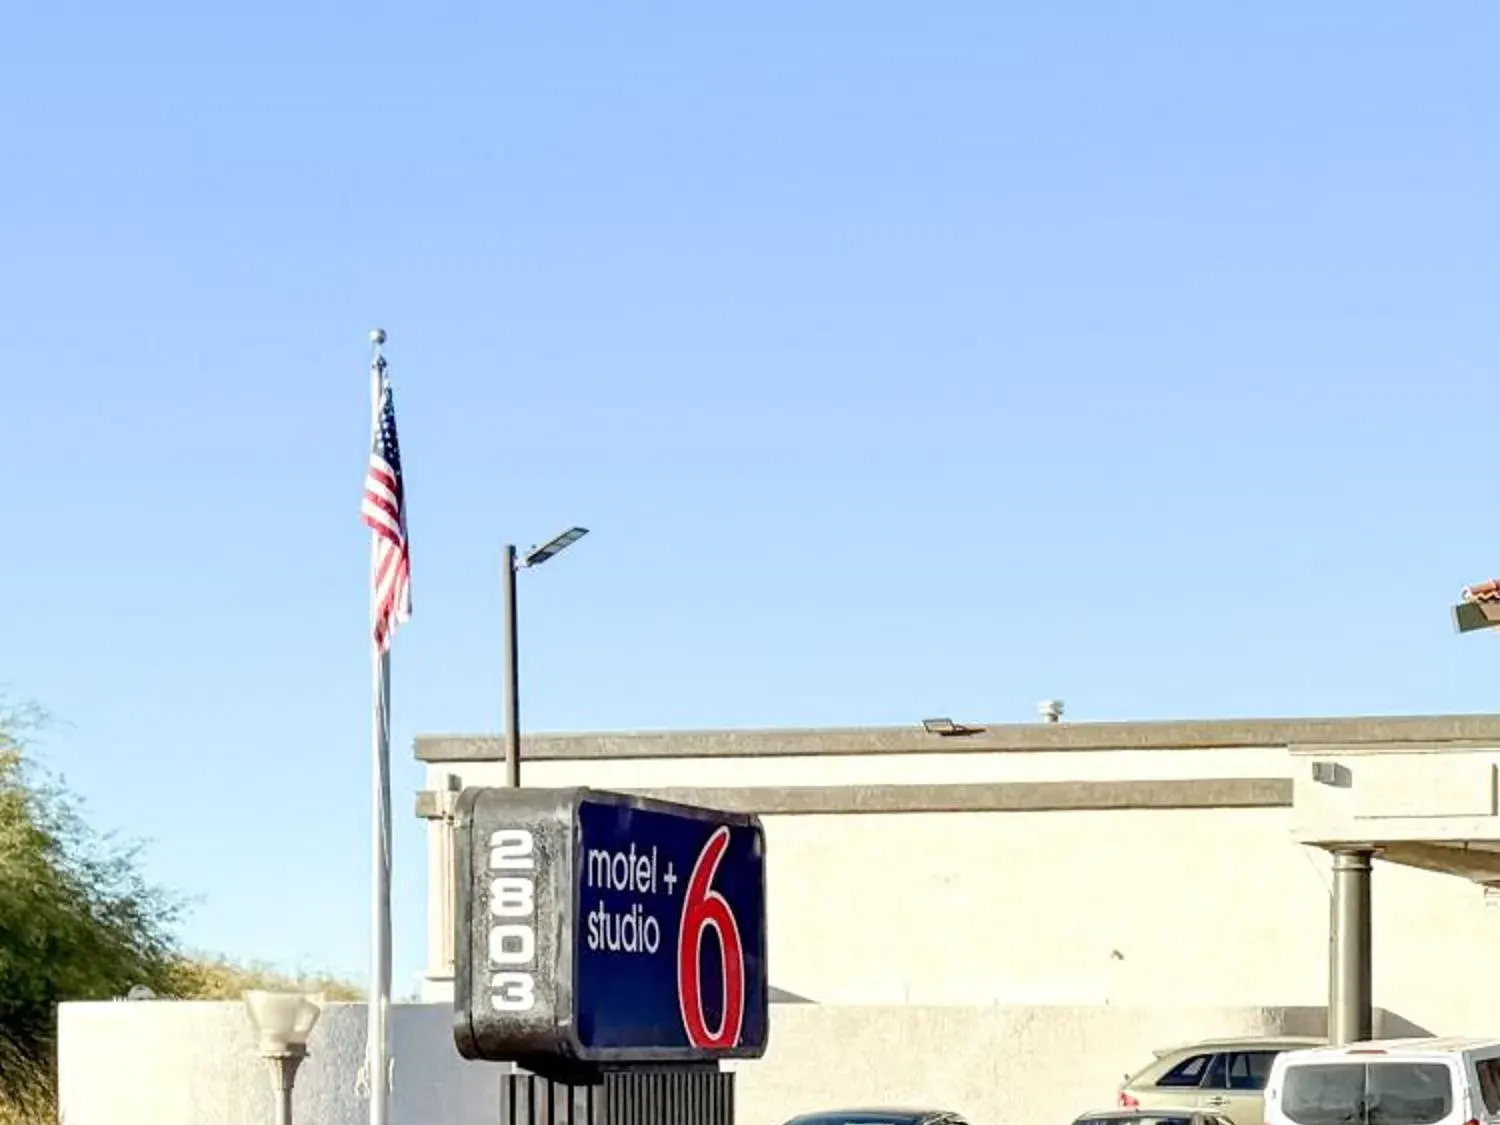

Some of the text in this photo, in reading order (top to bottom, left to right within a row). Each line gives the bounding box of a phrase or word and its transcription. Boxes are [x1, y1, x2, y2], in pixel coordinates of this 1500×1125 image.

[489, 829, 535, 1011] 2803
[588, 842, 658, 893] motel
[588, 900, 661, 954] studio
[677, 825, 745, 1049] 6
